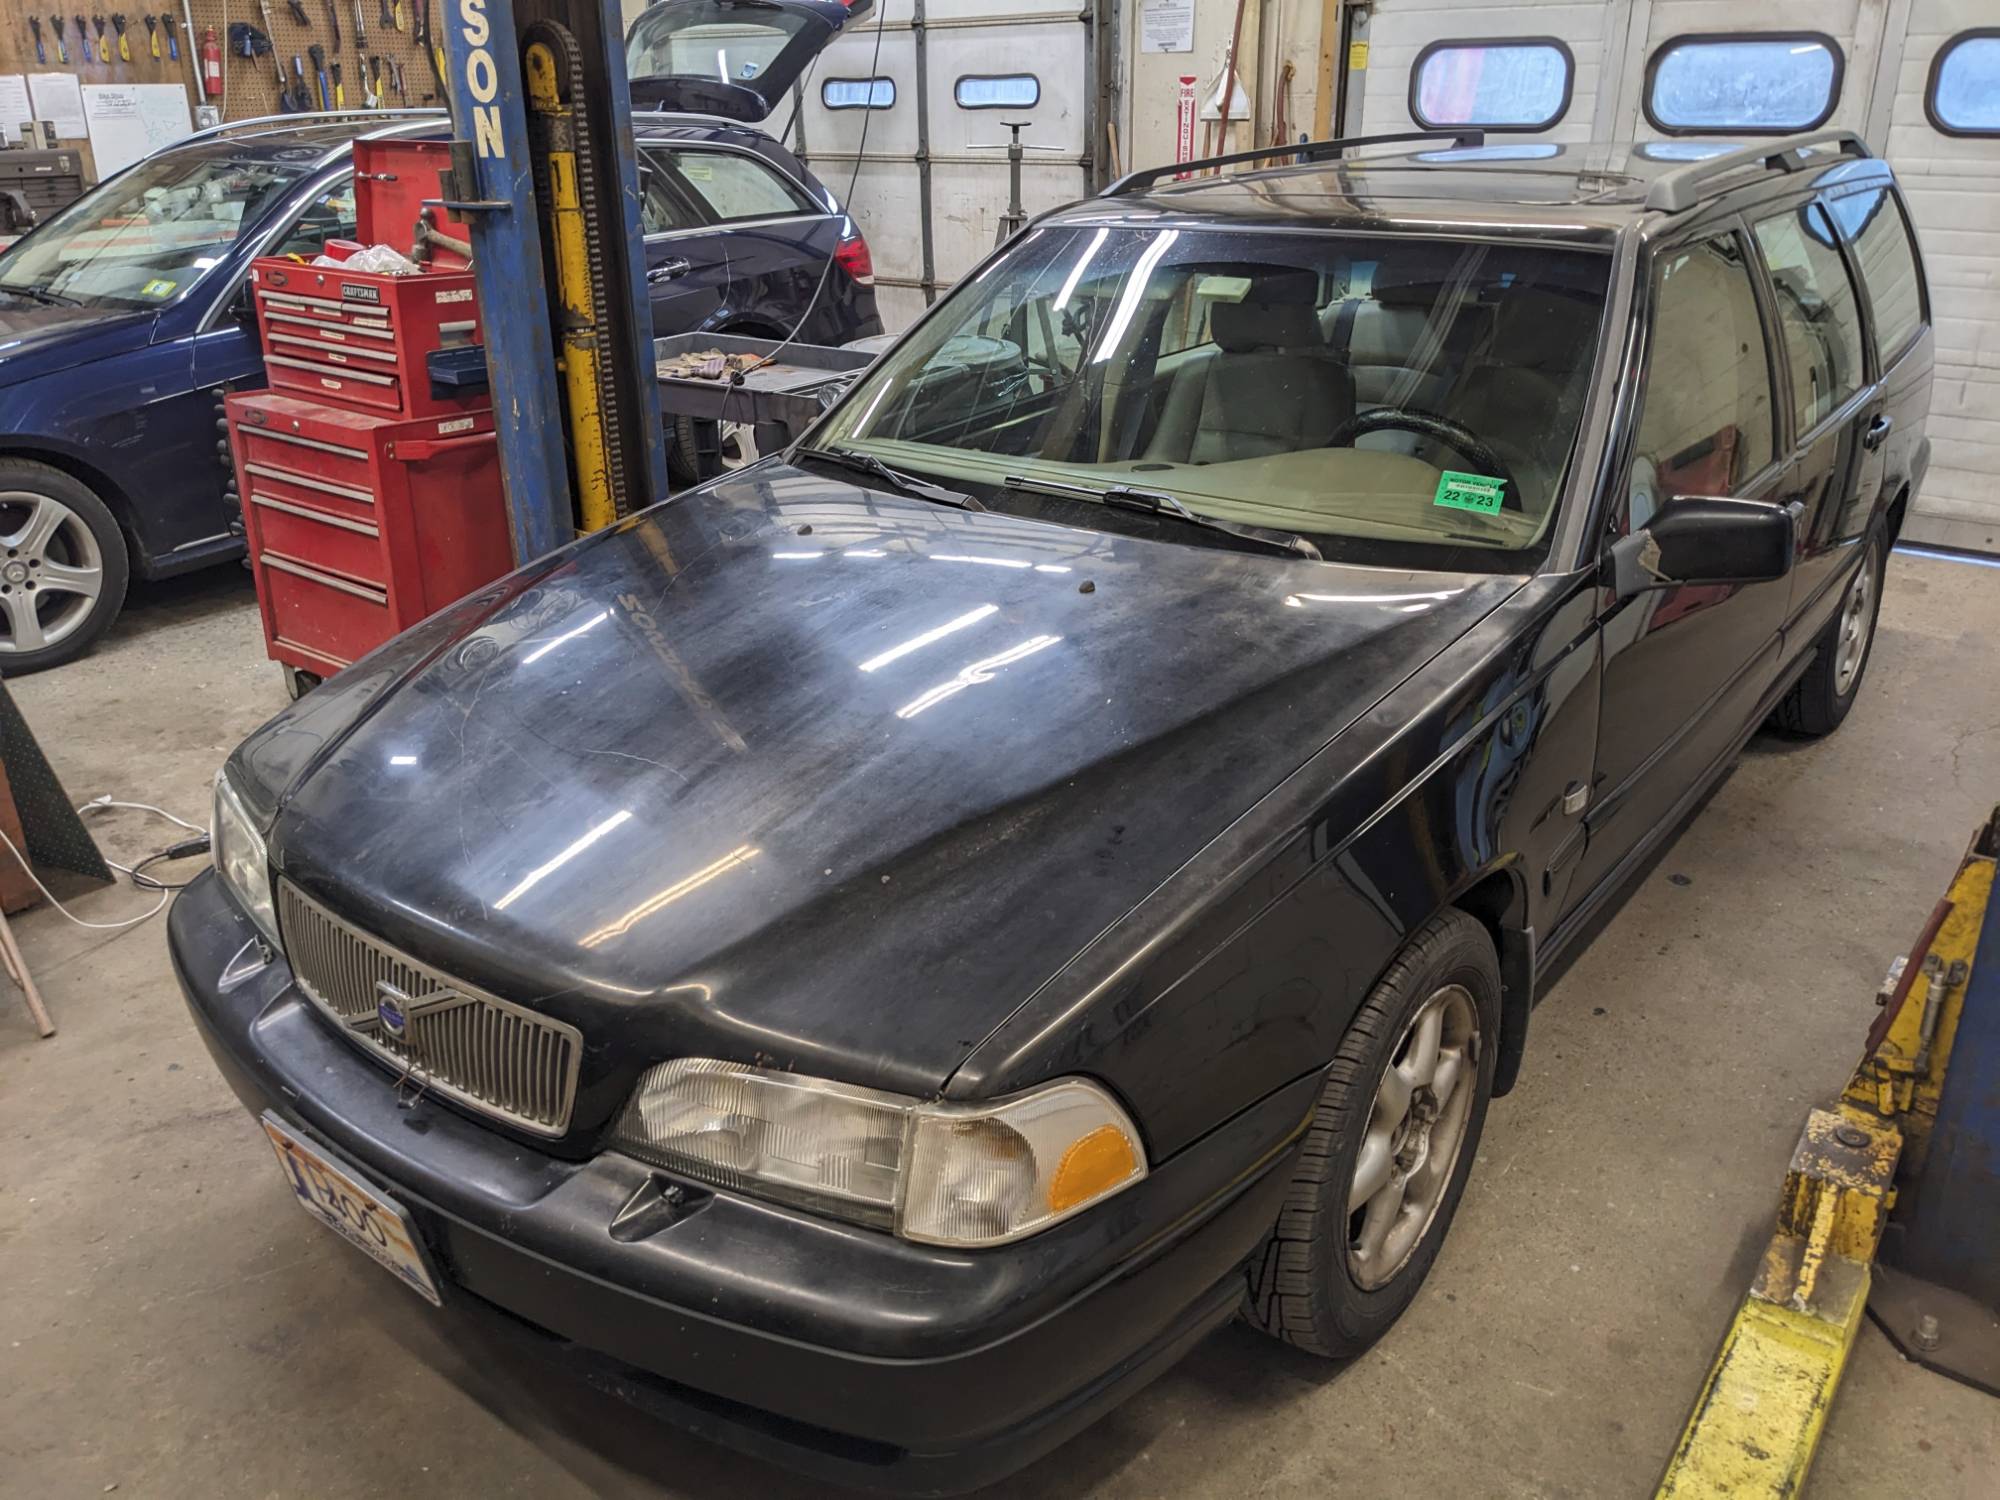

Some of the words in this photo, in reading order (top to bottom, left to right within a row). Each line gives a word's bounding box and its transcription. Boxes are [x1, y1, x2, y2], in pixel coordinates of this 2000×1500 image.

[460, 0, 505, 158] SON
[1180, 88, 1194, 97] FIRE
[1182, 100, 1190, 163] EXTINGUISHE
[343, 285, 378, 300] CRAFTSMAN
[1443, 490, 1460, 501] 22
[1476, 495, 1494, 507] 23
